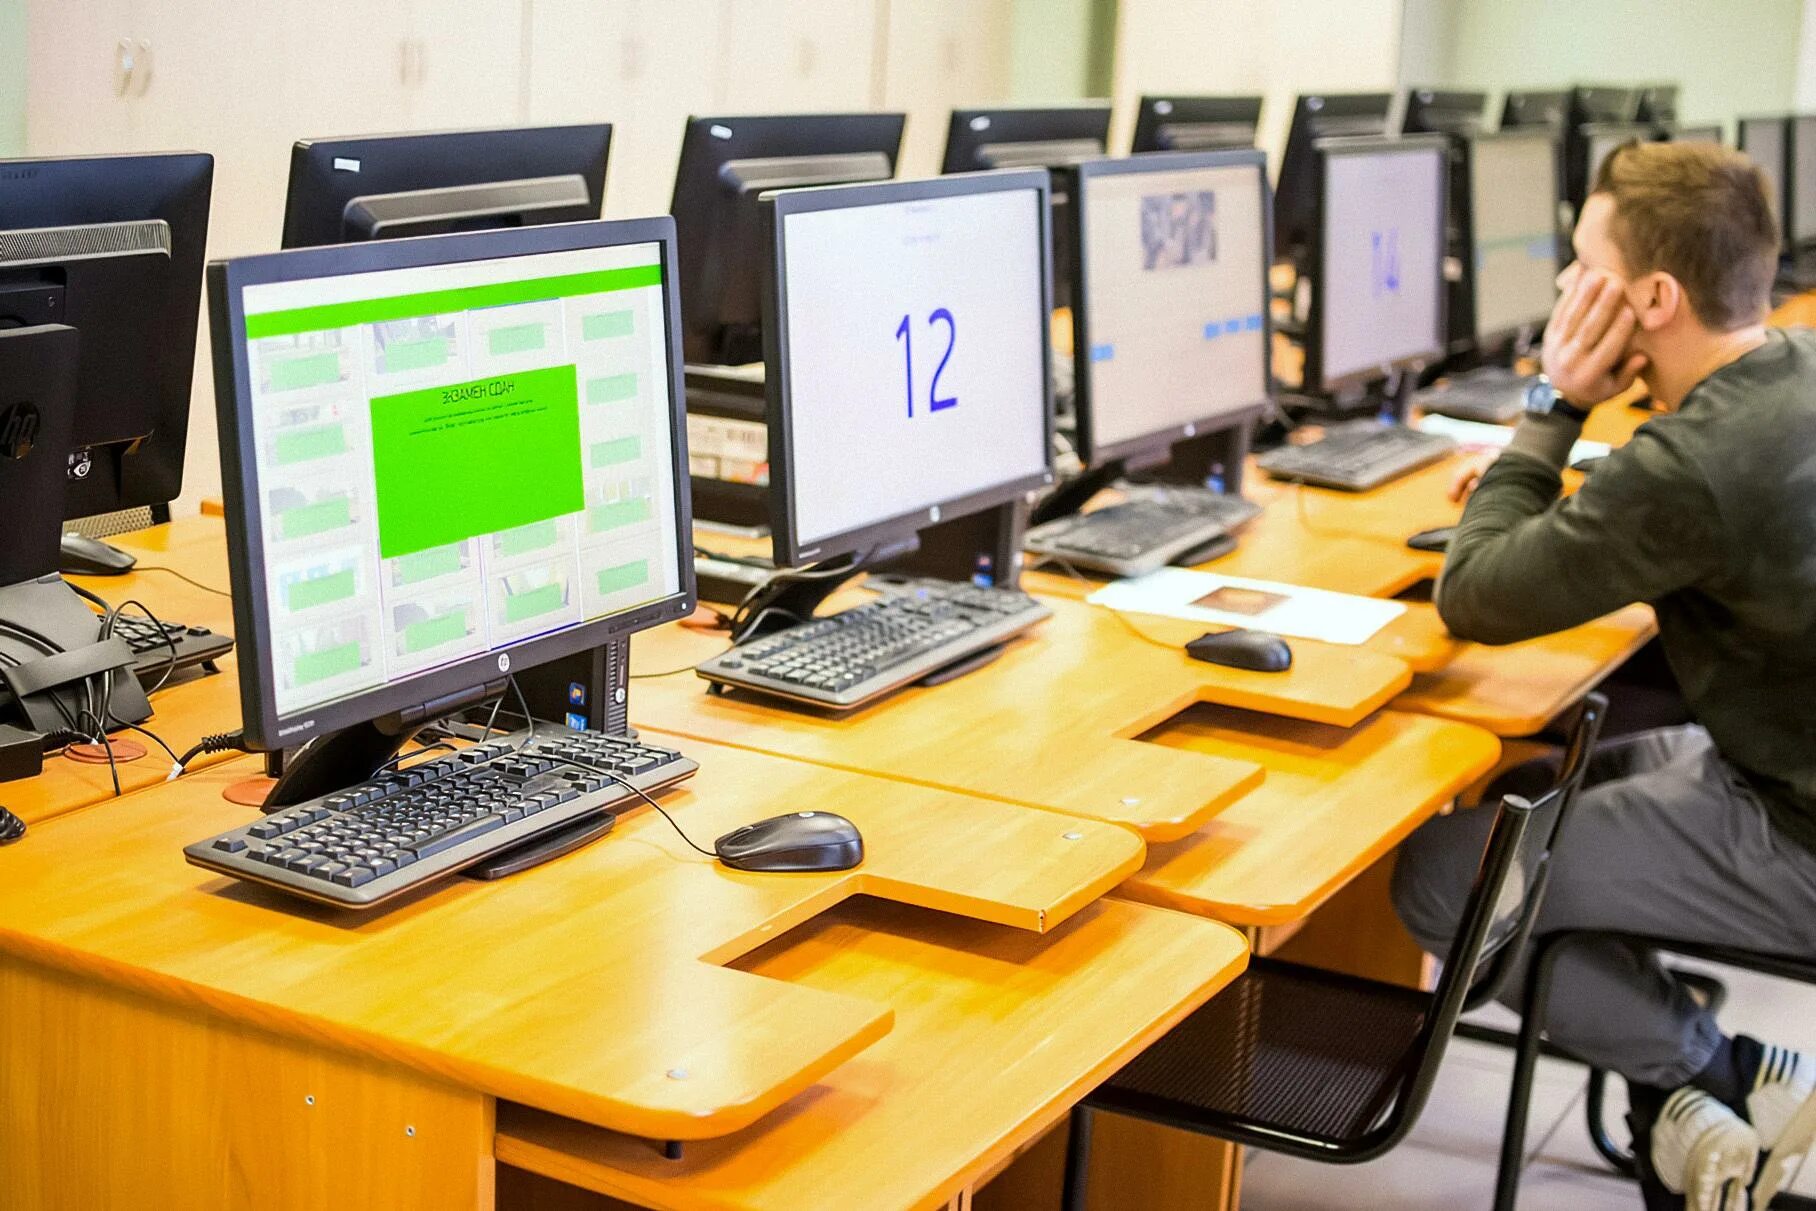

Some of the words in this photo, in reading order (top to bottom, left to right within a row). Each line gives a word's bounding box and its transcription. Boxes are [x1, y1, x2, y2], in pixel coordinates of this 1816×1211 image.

[442, 385, 487, 405] ЭКЗАМЕН
[488, 381, 515, 397] СДАН
[895, 308, 958, 418] 12
